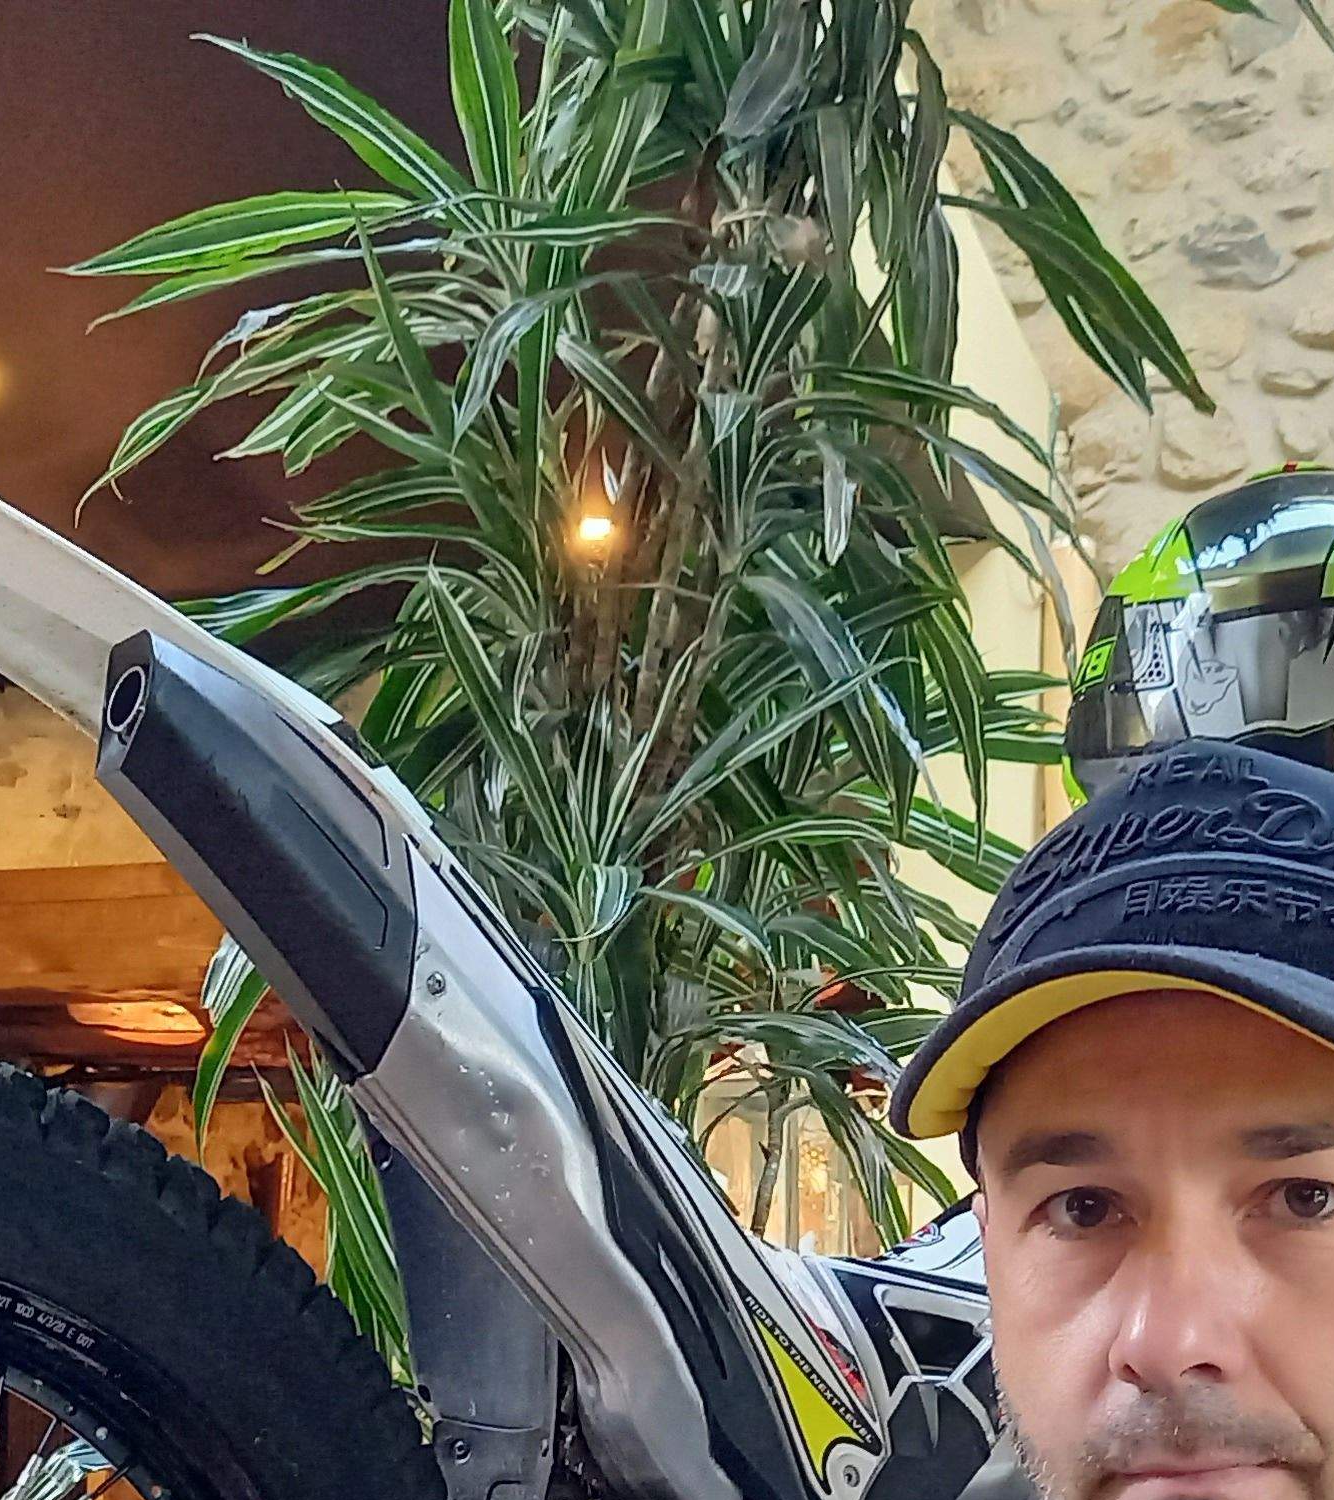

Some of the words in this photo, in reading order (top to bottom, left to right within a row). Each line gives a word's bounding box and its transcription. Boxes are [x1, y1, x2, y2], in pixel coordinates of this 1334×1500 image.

[1127, 753, 1270, 796] REAL
[745, 1296, 774, 1328] RIDE
[773, 1326, 790, 1347] TO
[789, 1347, 812, 1373] THE
[810, 1374, 841, 1407] NEXT
[839, 1407, 873, 1443] LEVEL
